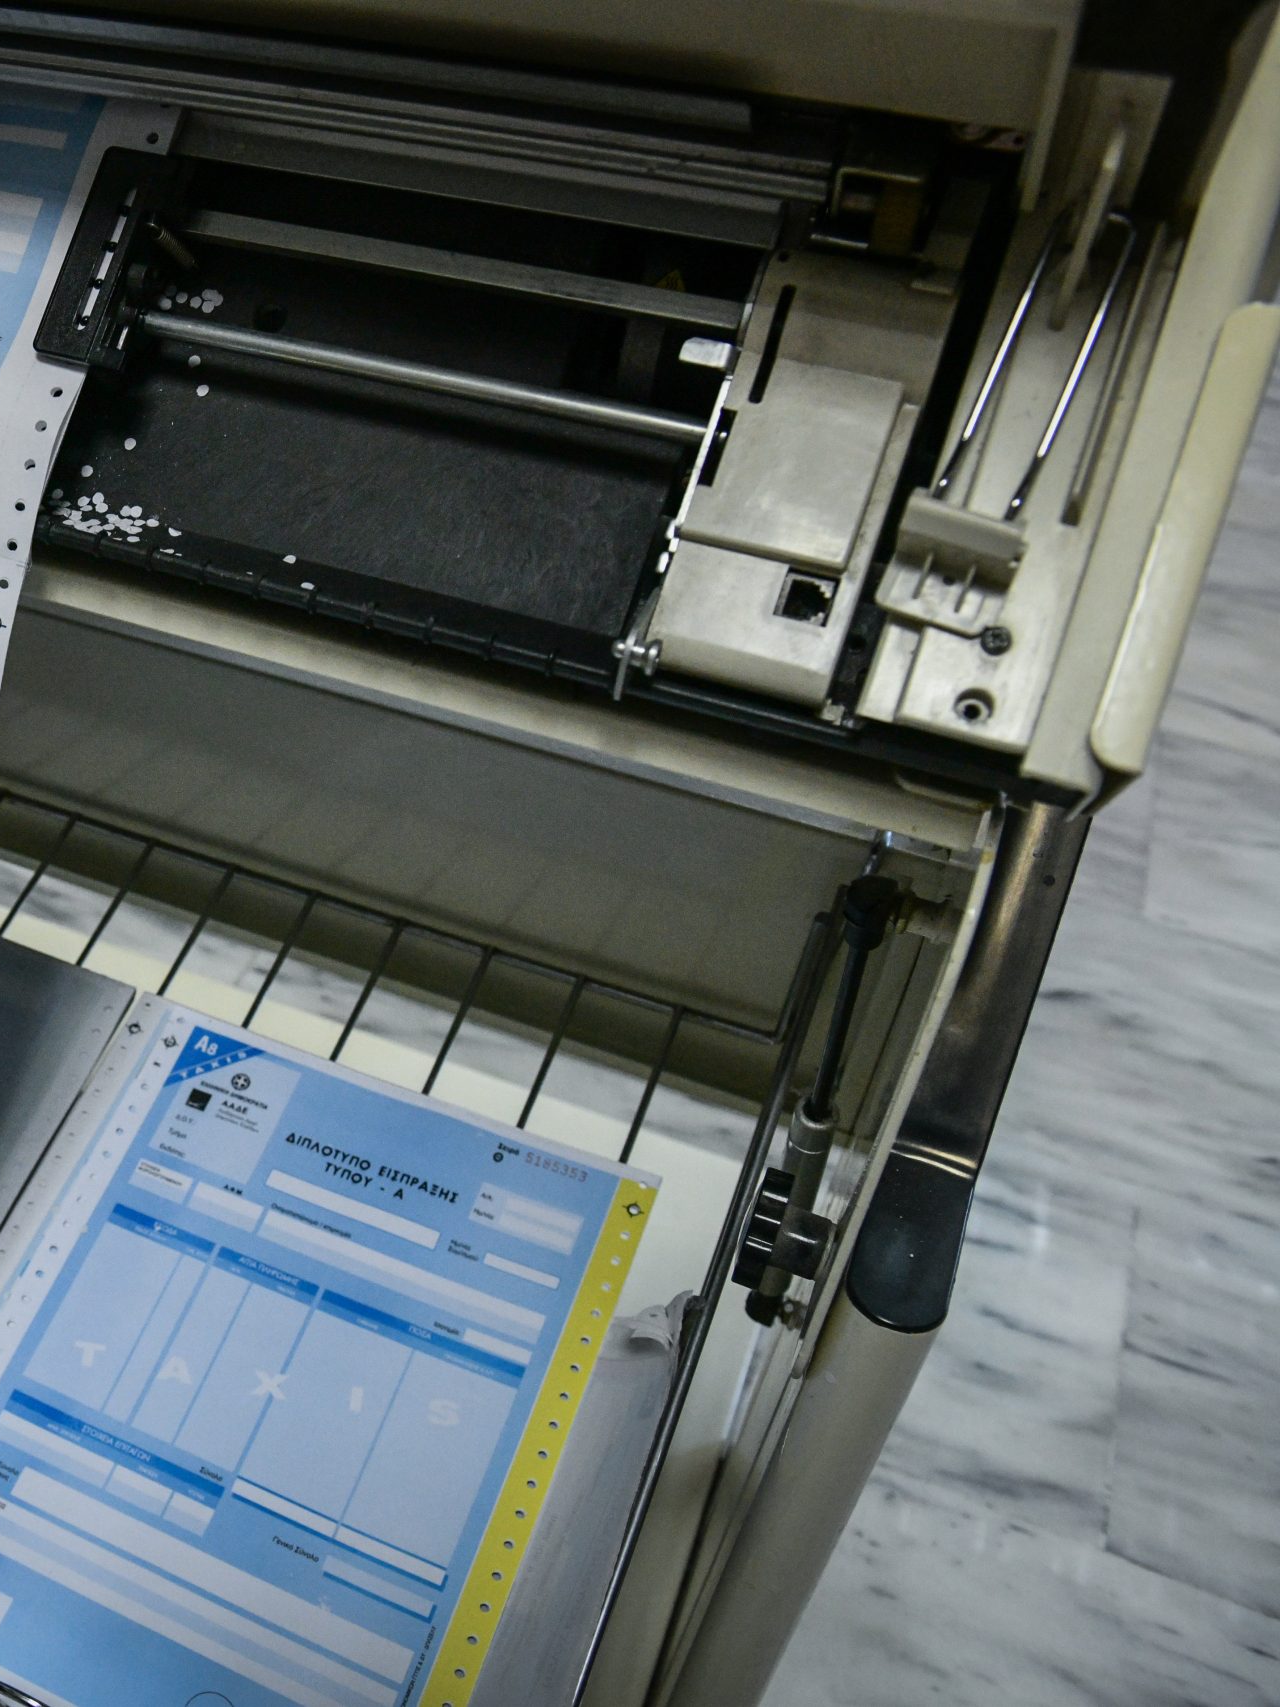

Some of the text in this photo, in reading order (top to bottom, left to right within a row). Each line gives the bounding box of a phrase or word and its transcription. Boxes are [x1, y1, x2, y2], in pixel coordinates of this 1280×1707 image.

[194, 1034, 218, 1056] A8
[285, 1132, 460, 1204] ΔΙΠΛΟΤΥΠΟ ΕΙΣΠΡΑΞΗΣ
[324, 1162, 373, 1187] ΤΥΠΟΥ
[393, 1188, 404, 1200] Α
